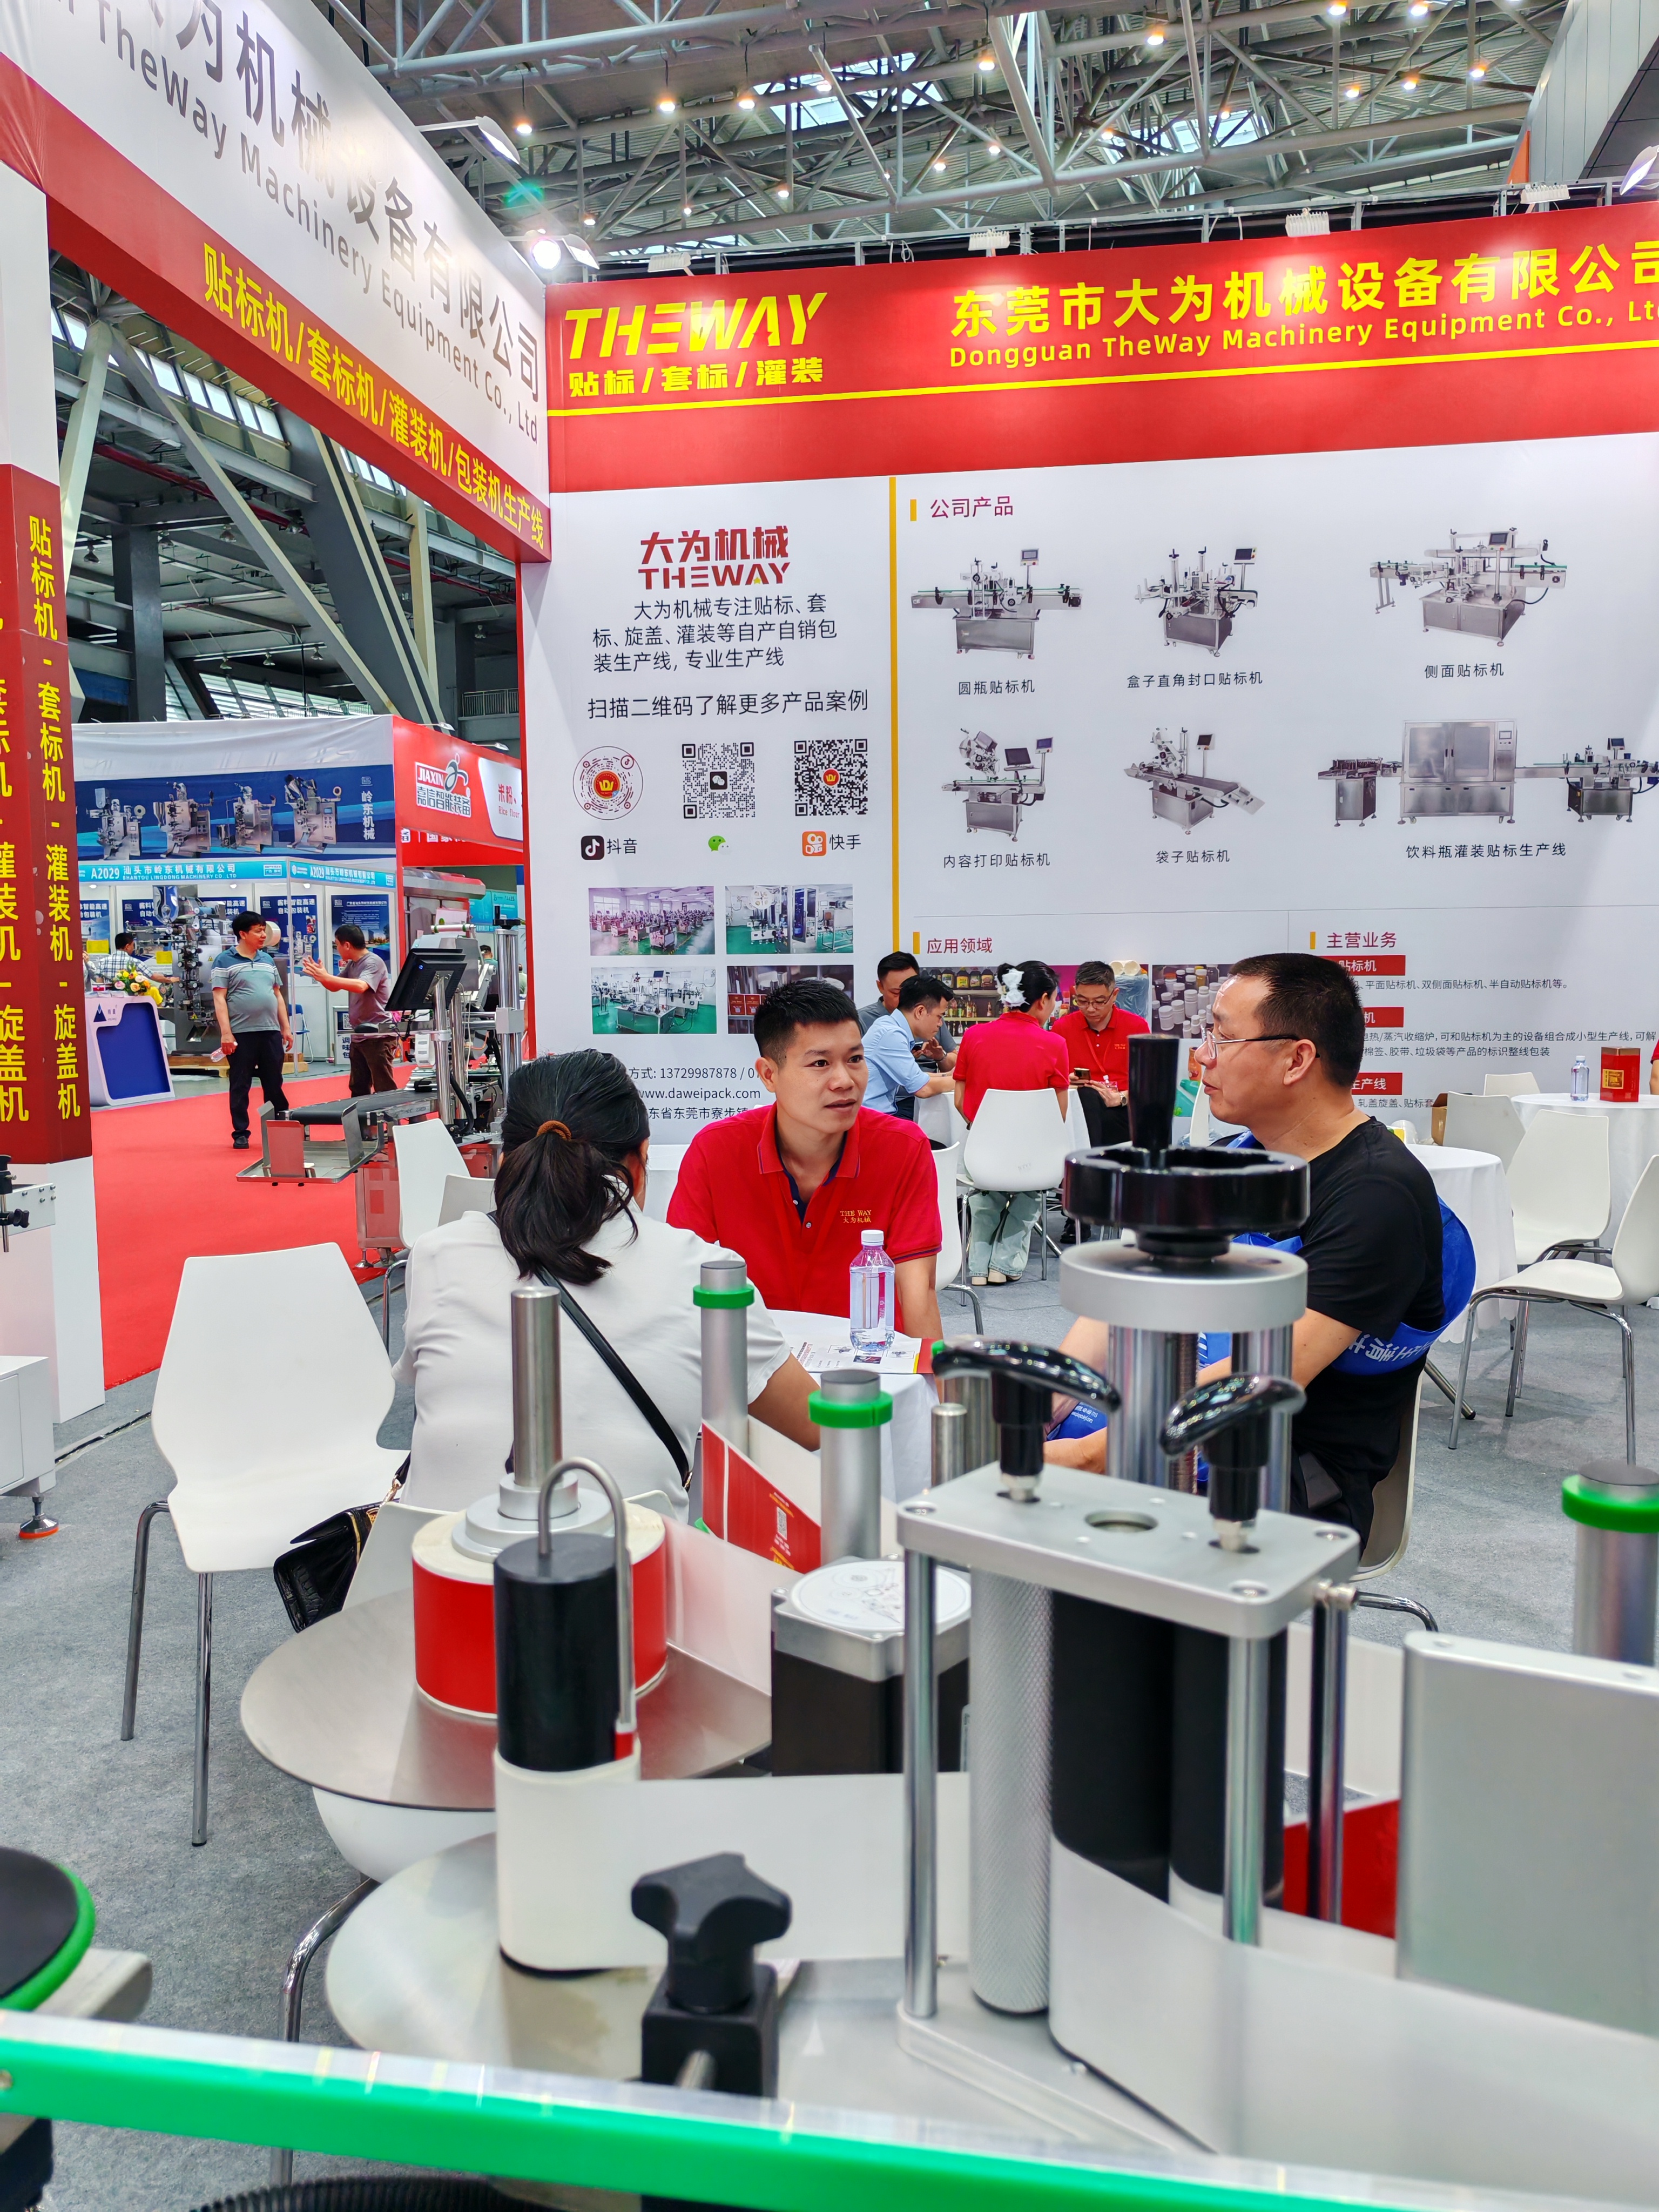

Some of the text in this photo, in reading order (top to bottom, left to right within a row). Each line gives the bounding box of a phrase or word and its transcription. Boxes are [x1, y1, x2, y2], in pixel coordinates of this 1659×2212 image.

[151, 0, 539, 403] 为机械设备有限公司
[240, 131, 372, 295] Machinery
[381, 268, 478, 390] Equipment
[485, 370, 512, 424] Co.,
[517, 401, 538, 444] Ltd
[950, 240, 1659, 340] 东莞市大为机械设备有限公司
[565, 292, 827, 359] THEWAY
[950, 300, 1659, 369] Dongguan TheWay Machinery Equipment Co., Lt
[204, 242, 544, 549] 贴标机/套标机/灌装机/包装机生产线
[930, 496, 1014, 519] 公司产品
[640, 525, 789, 565] 大为机械
[638, 562, 791, 590] THEWAY
[634, 593, 827, 621] 大为机械专注贴标、套
[592, 618, 837, 648] 标、旋盖、灌装等自产自销包
[1127, 671, 1263, 689] 盒子直角封口贴标机
[1424, 662, 1505, 679] 侧面贴标机
[958, 679, 1036, 696] 圆瓶贴标机
[588, 689, 868, 719] 扫描二维码了解更多产品案例
[417, 767, 444, 786] JIAXIN
[361, 791, 375, 840] 岭东机械
[606, 838, 638, 855] 抖音
[829, 834, 862, 851] 快手
[1406, 842, 1567, 859] 饮料瓶灌装贴标生产线
[943, 852, 1051, 869] 内容打印贴标机
[1156, 849, 1231, 864] 袋子贴标机
[91, 868, 120, 879] A2029
[123, 864, 235, 875] 汕头市岭东机械有限公司
[927, 937, 993, 954] 应用领域
[1326, 932, 1398, 949] 主营业务
[660, 1068, 738, 1078] 13729987878
